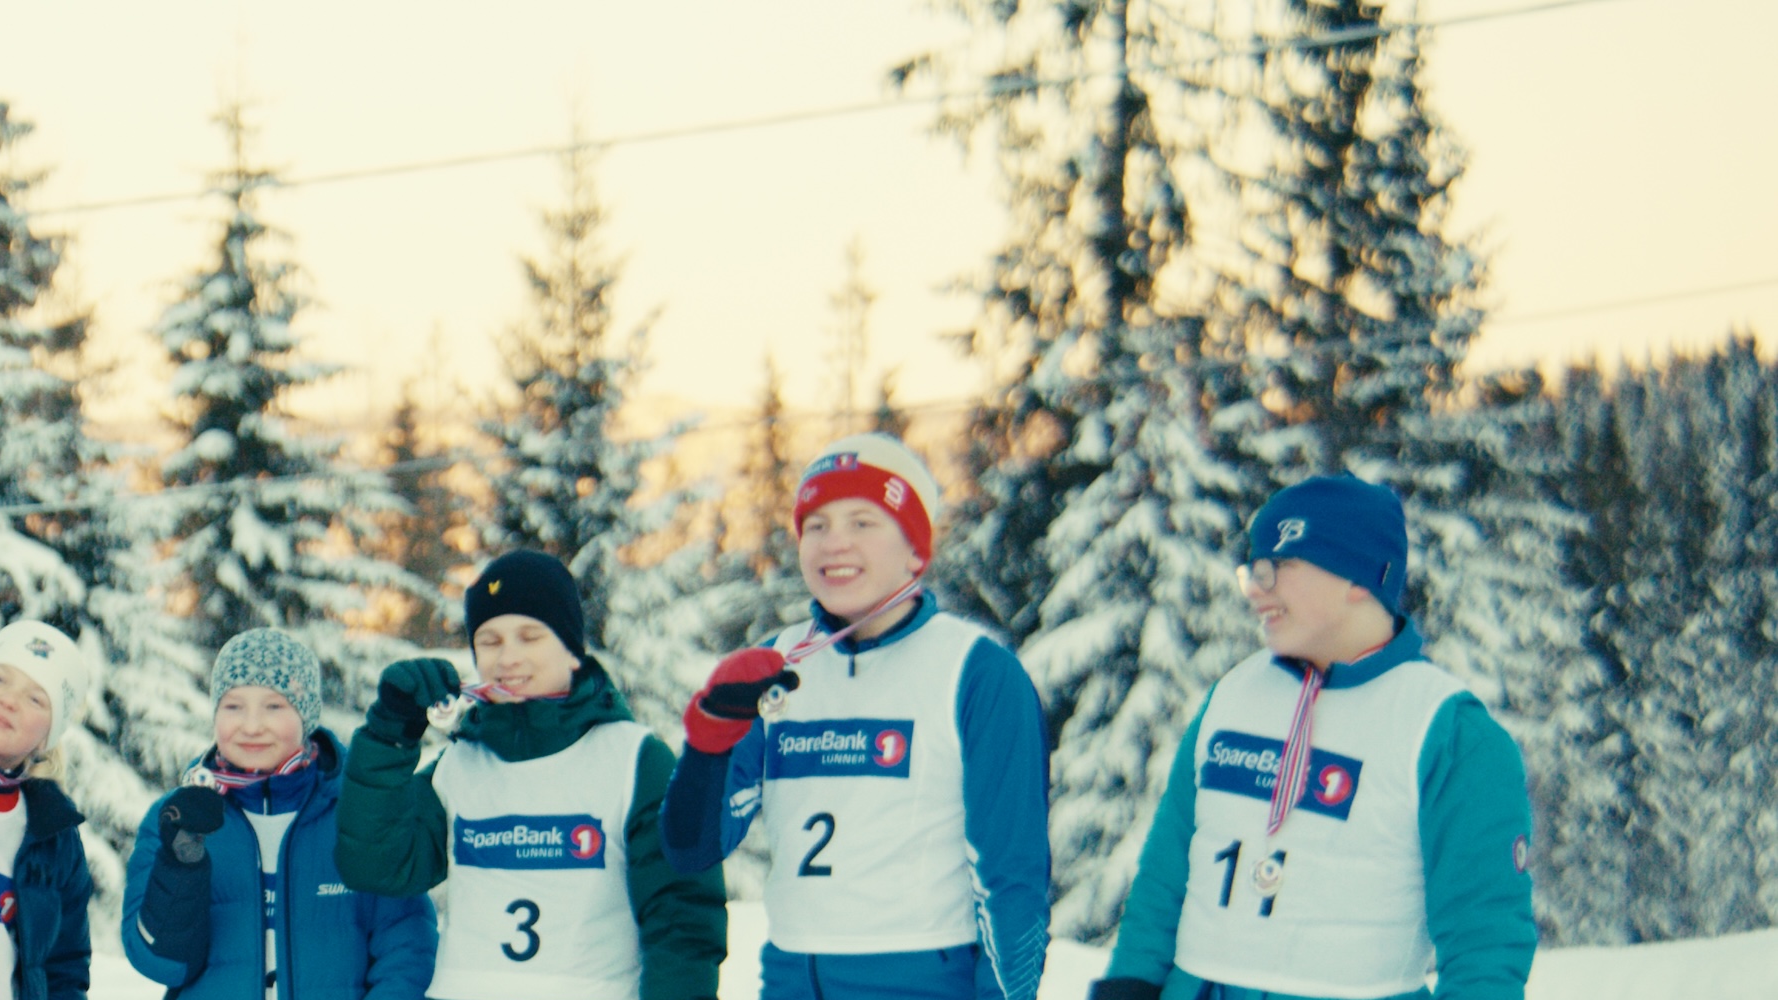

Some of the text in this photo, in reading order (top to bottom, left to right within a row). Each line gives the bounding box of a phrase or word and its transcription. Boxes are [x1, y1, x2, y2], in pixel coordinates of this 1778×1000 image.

[777, 729, 896, 762] SpareBank 1
[821, 752, 867, 765] LUNNER
[1208, 741, 1343, 801] SpareBa 1
[462, 824, 591, 855] SpareBank 1
[516, 847, 563, 859] LUNNER
[797, 811, 837, 878] 2
[500, 898, 541, 963] 3
